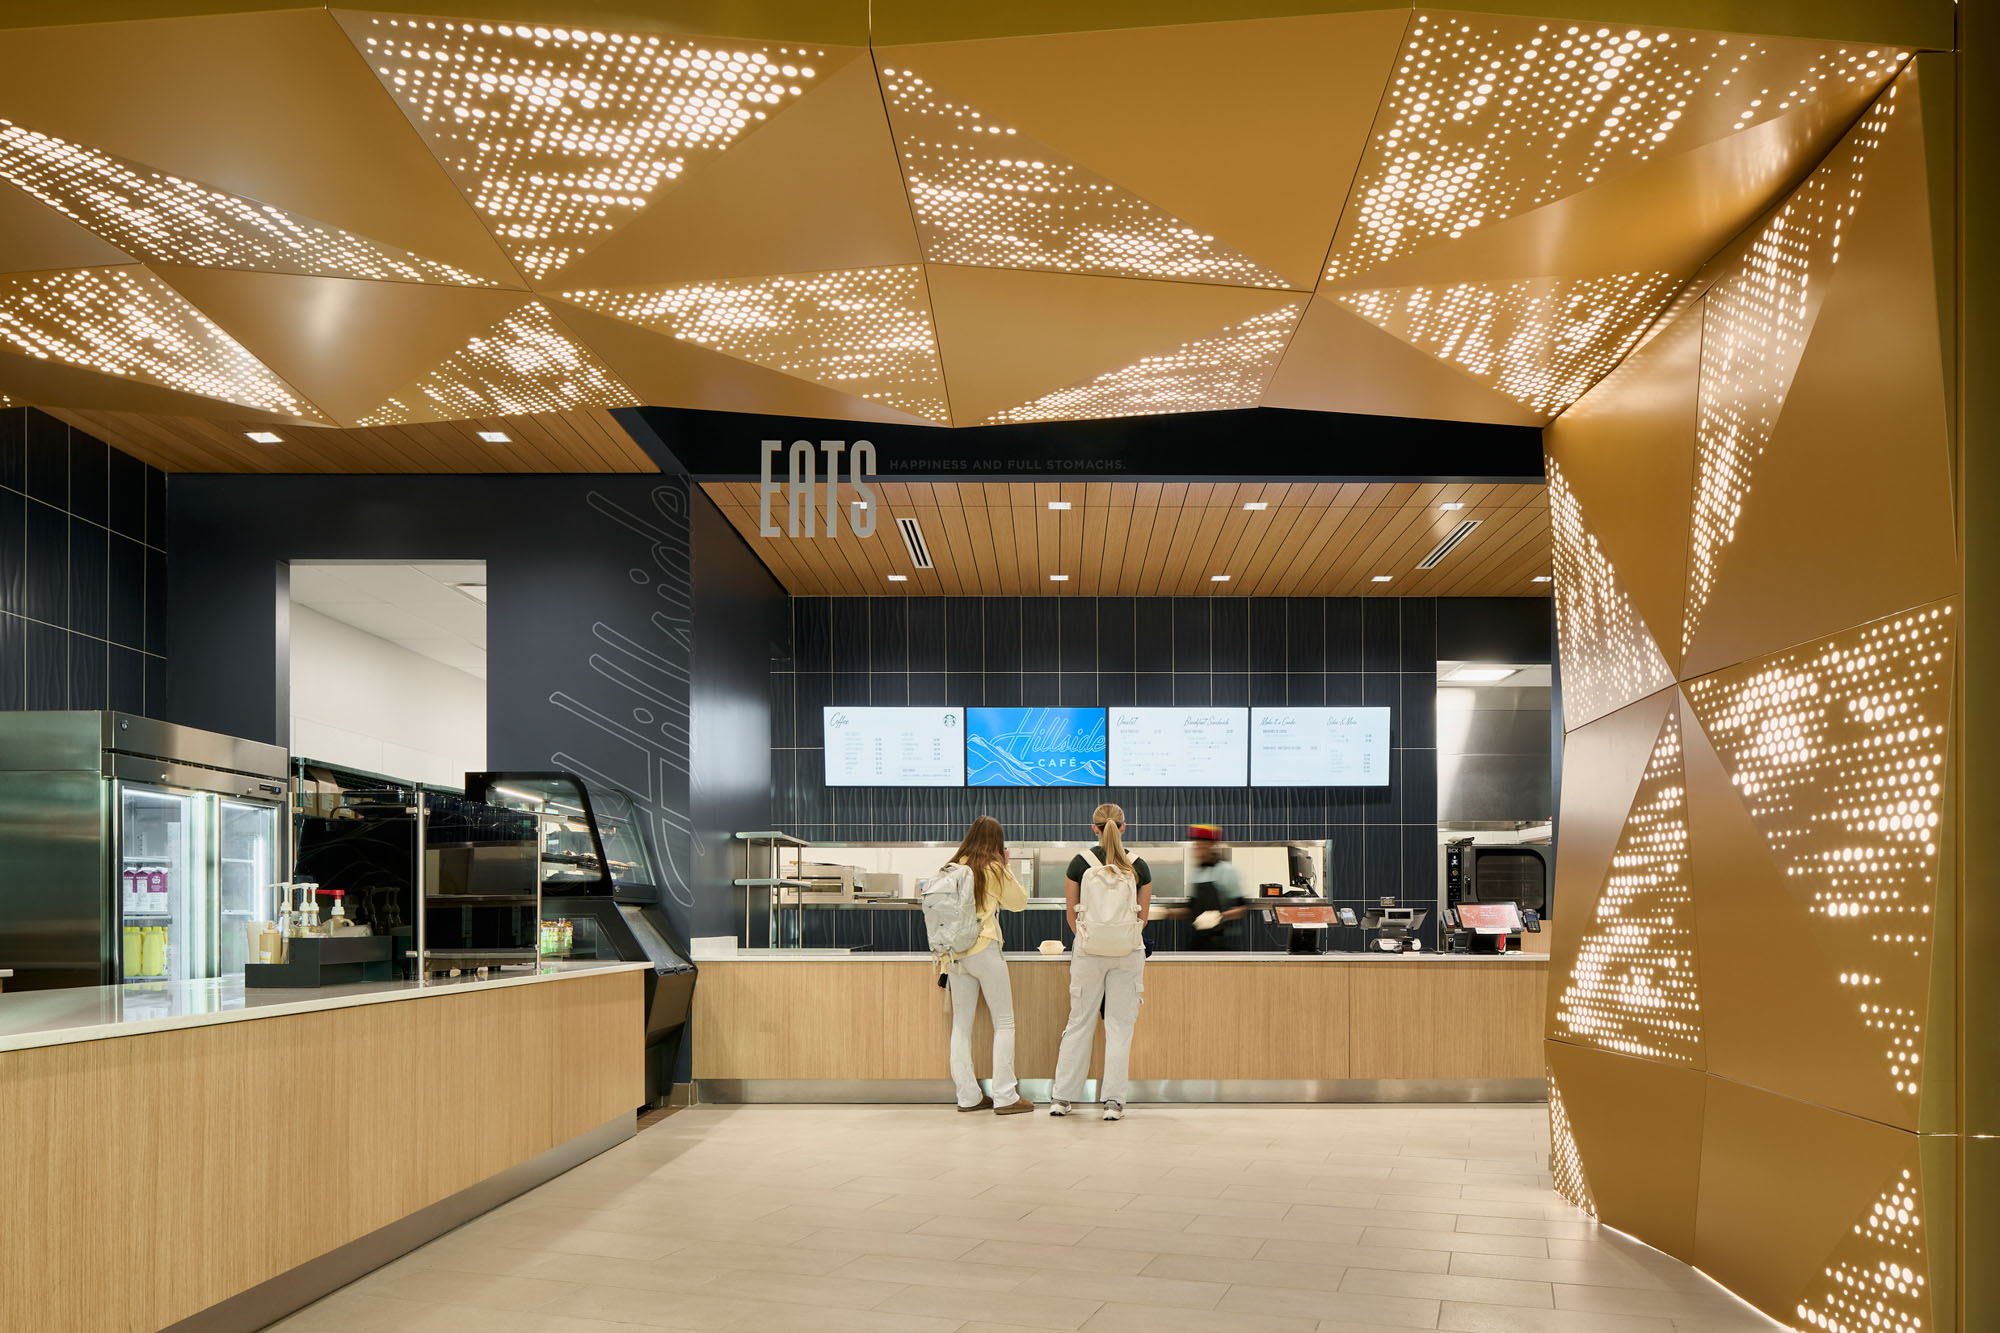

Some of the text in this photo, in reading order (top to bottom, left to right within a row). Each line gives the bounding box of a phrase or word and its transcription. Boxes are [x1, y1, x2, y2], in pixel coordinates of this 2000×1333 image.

[889, 459, 1127, 470] HAPPINESS AND FULL STOMACHS.
[760, 440, 877, 538] EATS
[829, 711, 849, 729] Coffee
[989, 708, 1106, 760] Hillside
[1038, 757, 1077, 767] CAFÉ
